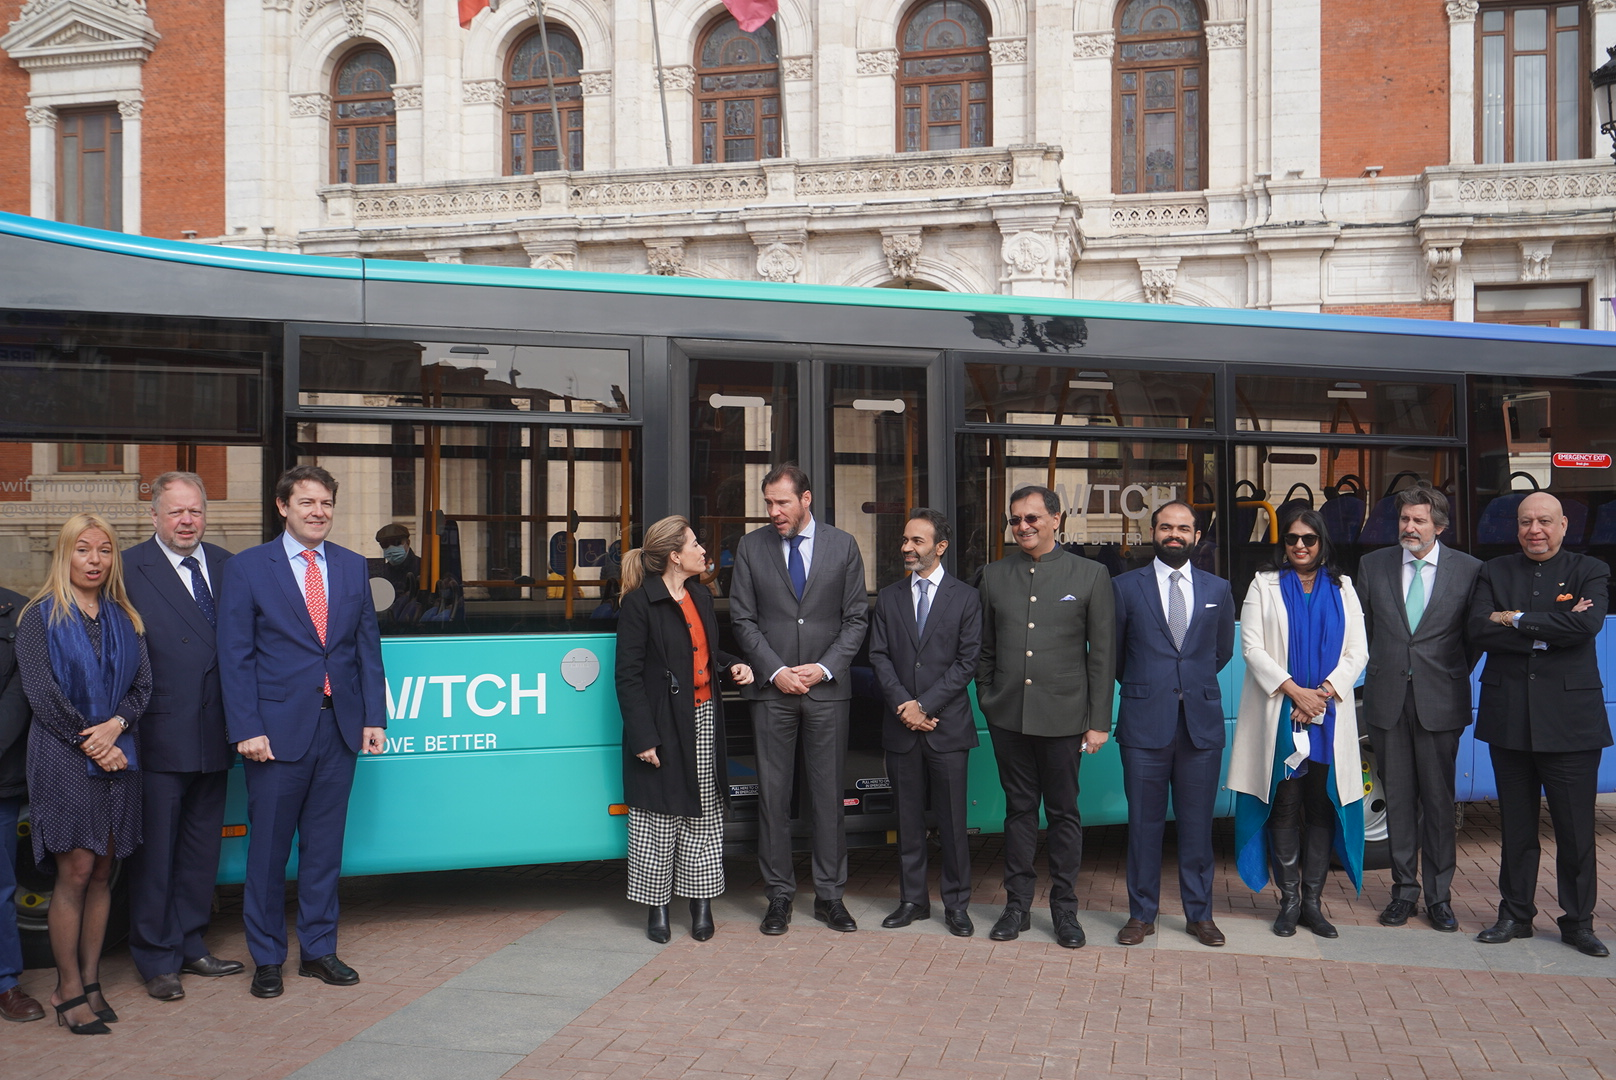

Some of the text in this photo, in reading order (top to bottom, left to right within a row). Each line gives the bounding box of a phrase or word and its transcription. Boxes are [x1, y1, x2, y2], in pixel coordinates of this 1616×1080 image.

[1558, 453, 1592, 461] EMERGENCY
[0, 477, 151, 497] witchmobility.te
[1015, 481, 1177, 519] WITCH
[2, 502, 151, 520] @switchEVglob
[1055, 532, 1142, 546] OVE BETTER
[424, 733, 497, 752] BETTER
